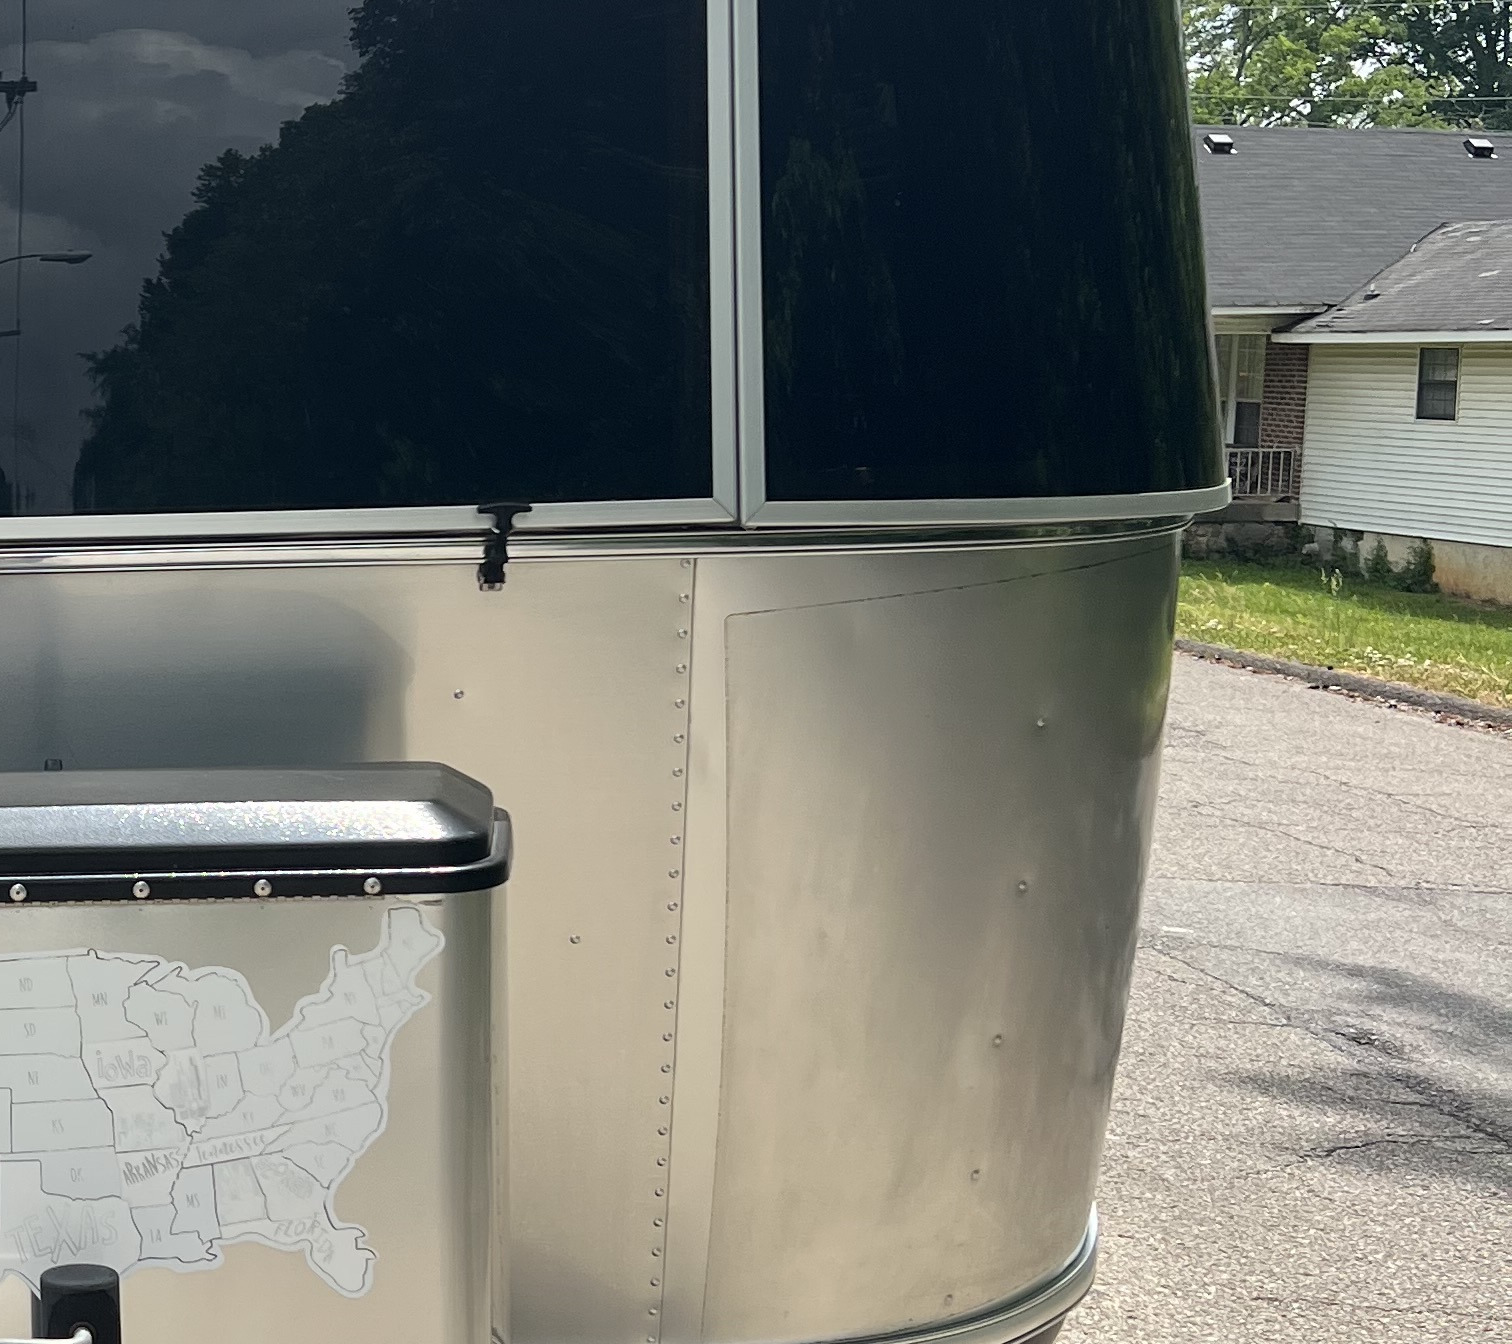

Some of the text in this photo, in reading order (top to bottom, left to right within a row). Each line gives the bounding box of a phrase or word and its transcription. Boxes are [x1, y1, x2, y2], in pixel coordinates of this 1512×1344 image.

[18, 977, 34, 992] ND
[23, 1022, 37, 1038] SD
[122, 1151, 181, 1186] ARKANSAS
[4, 1201, 119, 1265] TEXAS
[273, 1219, 335, 1264] FLORIDA
